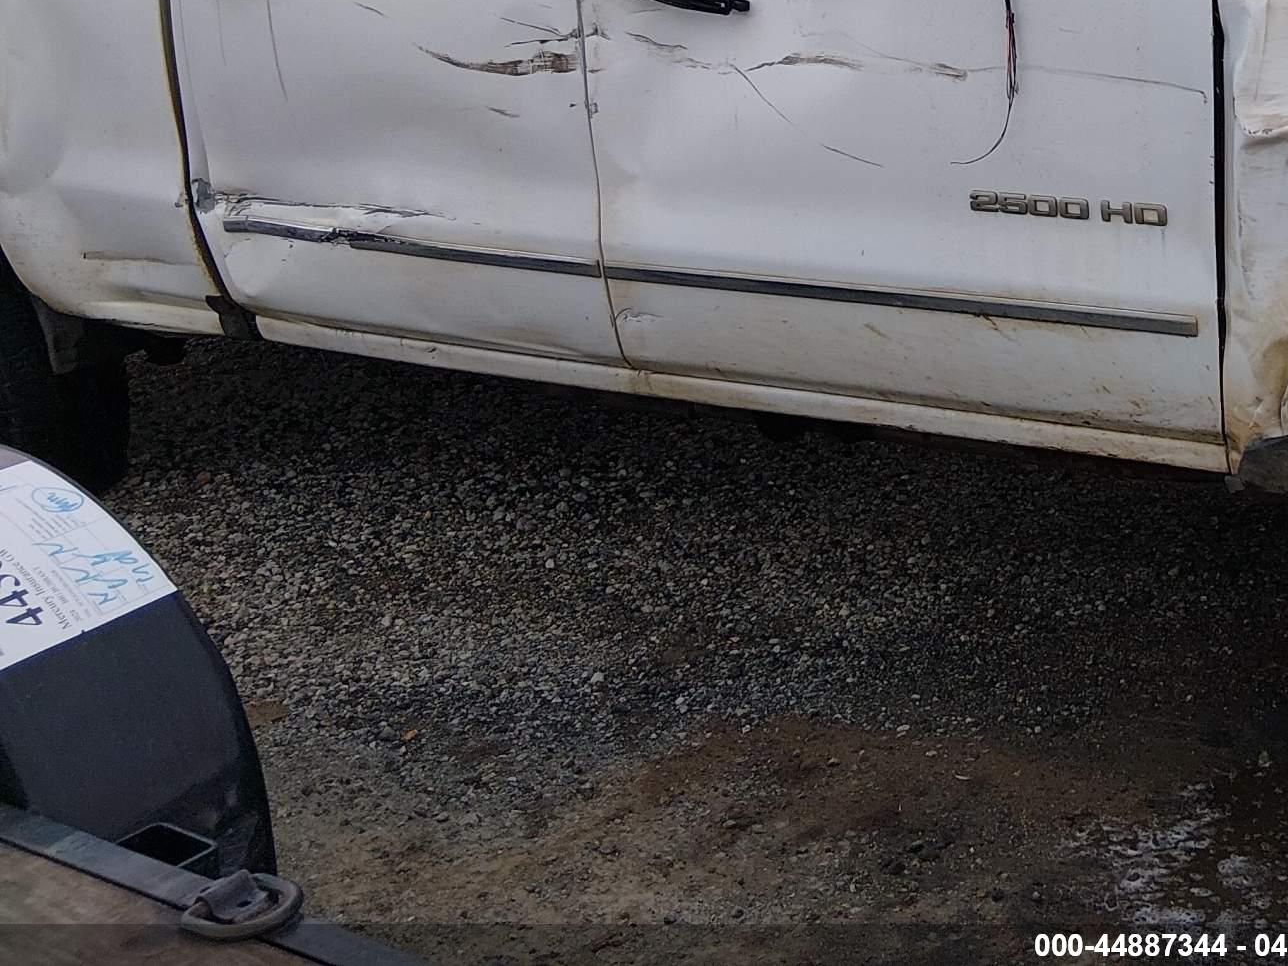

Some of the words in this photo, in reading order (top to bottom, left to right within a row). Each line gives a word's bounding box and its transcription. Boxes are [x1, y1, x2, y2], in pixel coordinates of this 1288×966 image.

[969, 190, 1090, 221] 2500
[1100, 199, 1168, 227] HD
[12, 560, 46, 596] Insurance
[43, 595, 73, 630] Mercury
